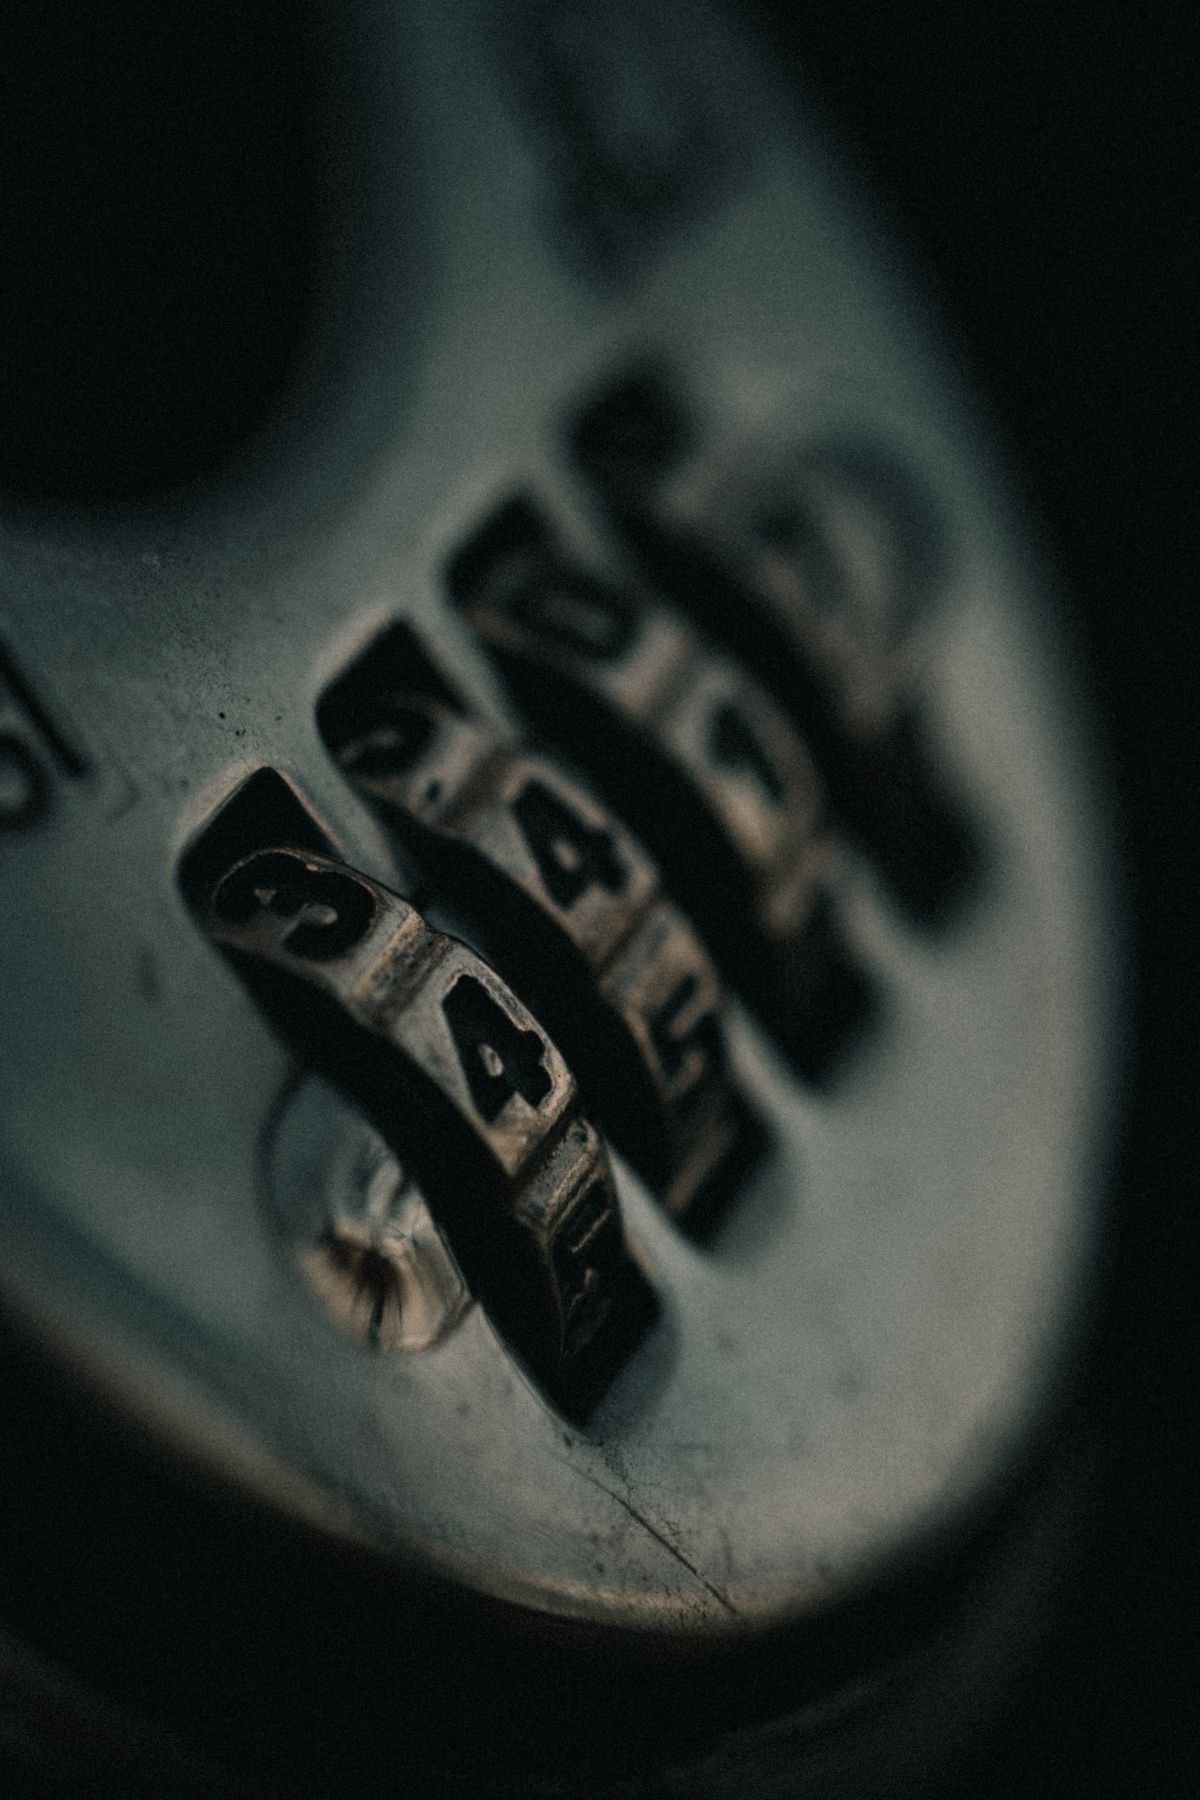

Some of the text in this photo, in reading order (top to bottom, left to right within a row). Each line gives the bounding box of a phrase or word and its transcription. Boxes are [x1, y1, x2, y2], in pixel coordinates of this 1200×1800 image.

[213, 852, 378, 962] 3
[442, 973, 553, 1122] 4
[511, 780, 628, 910] 4
